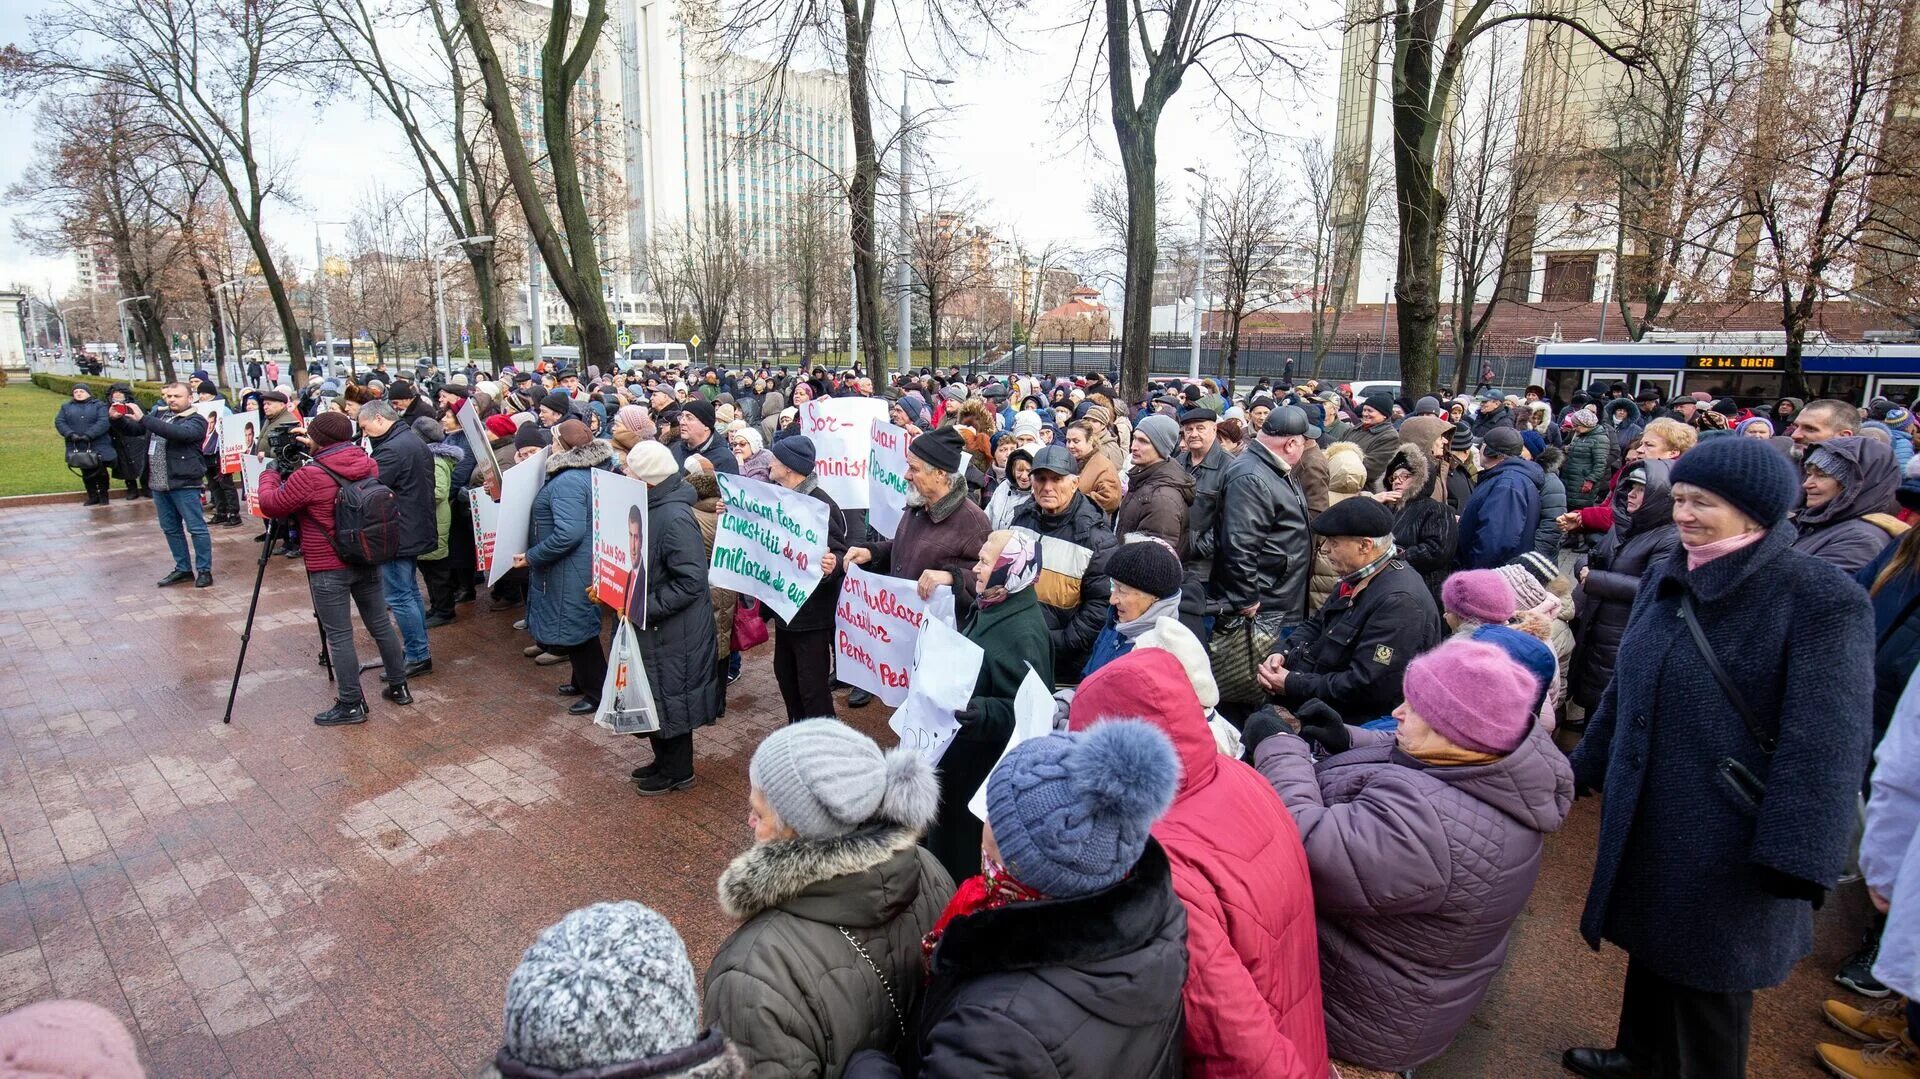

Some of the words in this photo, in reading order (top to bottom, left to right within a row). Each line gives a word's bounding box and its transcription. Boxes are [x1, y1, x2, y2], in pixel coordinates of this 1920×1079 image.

[1699, 358, 1713, 367] 22
[1740, 358, 1775, 367] DACIA
[806, 529, 818, 545] cu
[783, 540, 794, 561] de
[796, 552, 808, 572] 10
[714, 546, 771, 586] miliarde
[773, 570, 785, 592] de
